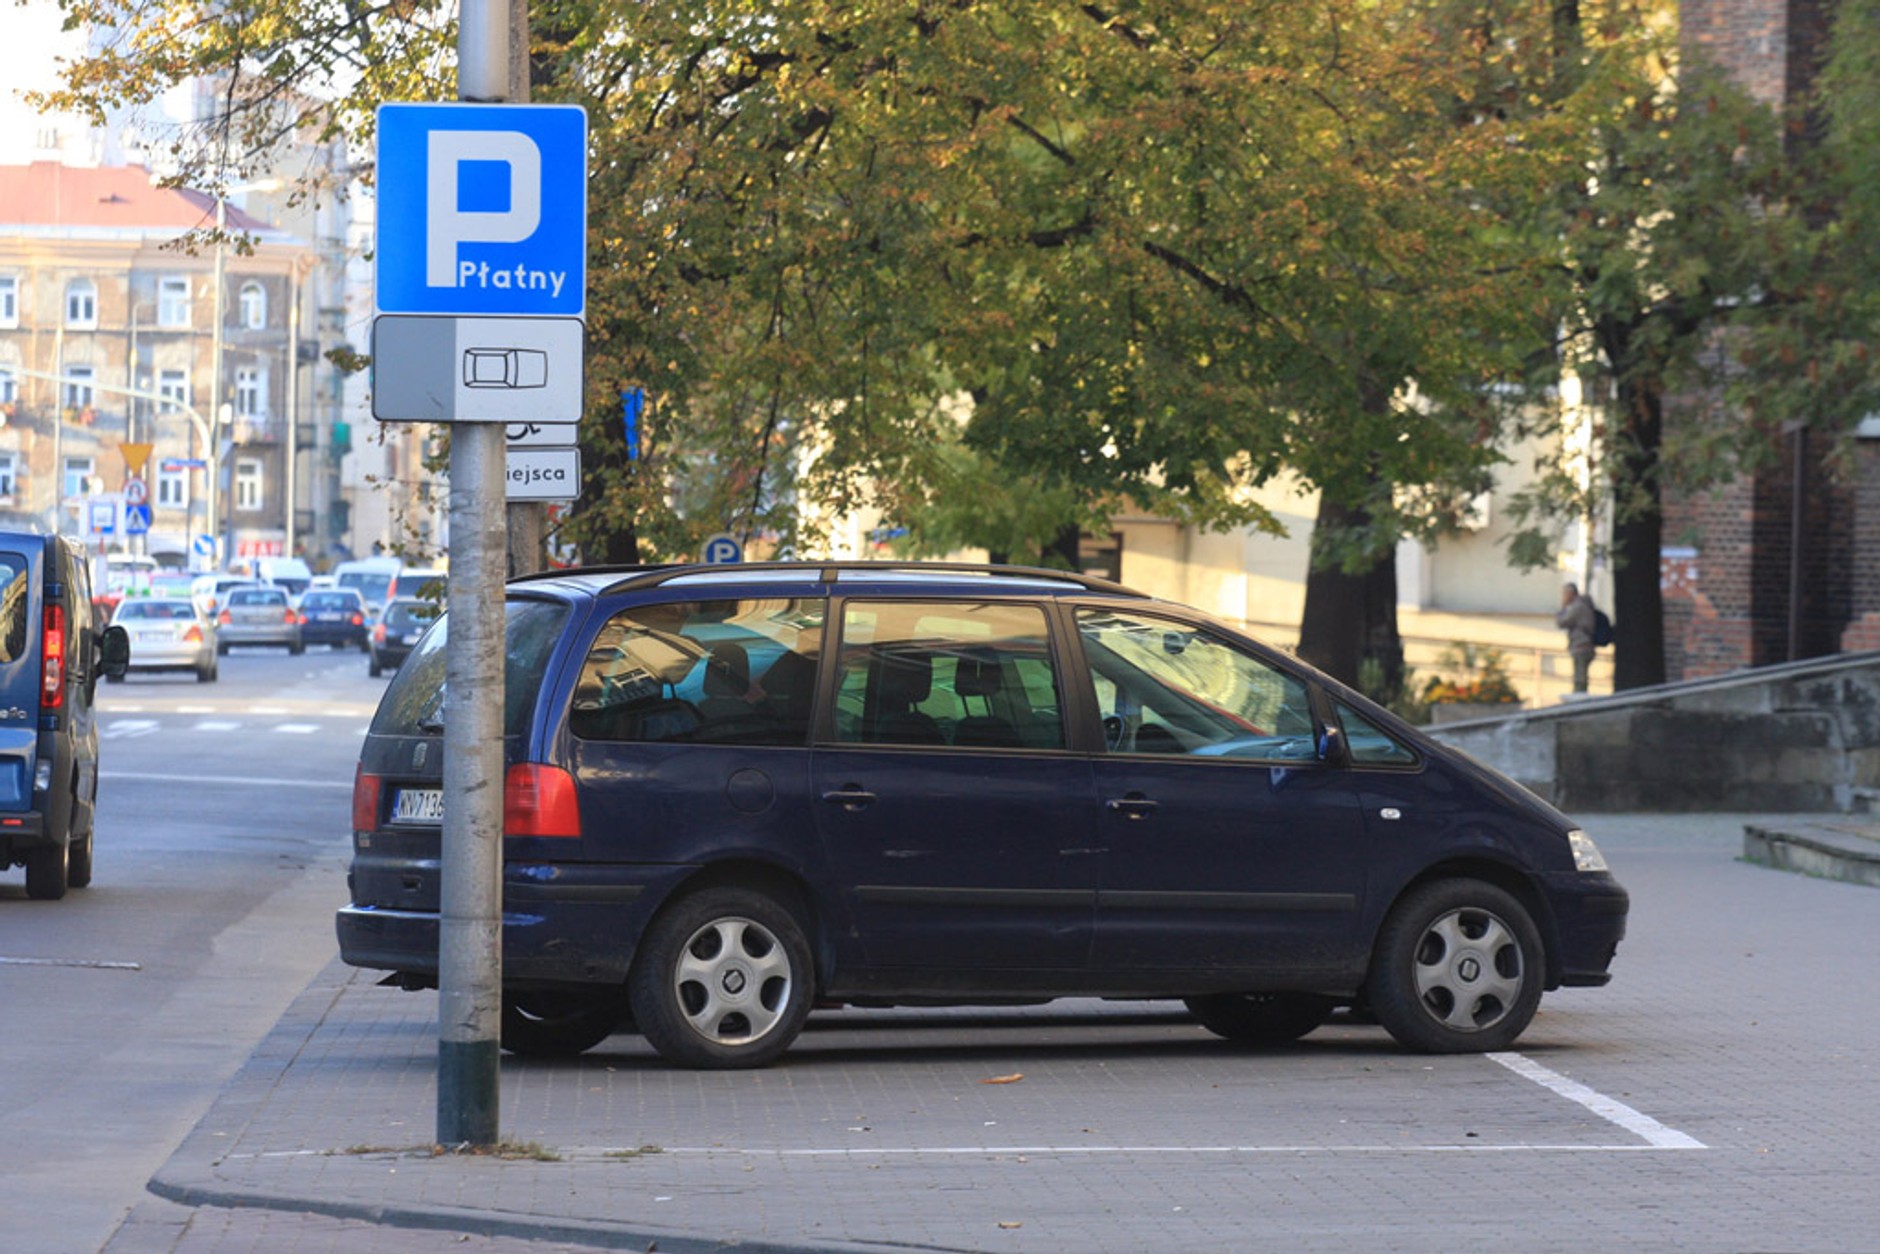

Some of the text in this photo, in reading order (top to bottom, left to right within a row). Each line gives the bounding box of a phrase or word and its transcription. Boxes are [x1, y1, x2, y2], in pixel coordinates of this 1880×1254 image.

[427, 130, 541, 288] P
[459, 261, 566, 298] Płatny
[507, 465, 565, 485] iejsca
[713, 543, 736, 563] P
